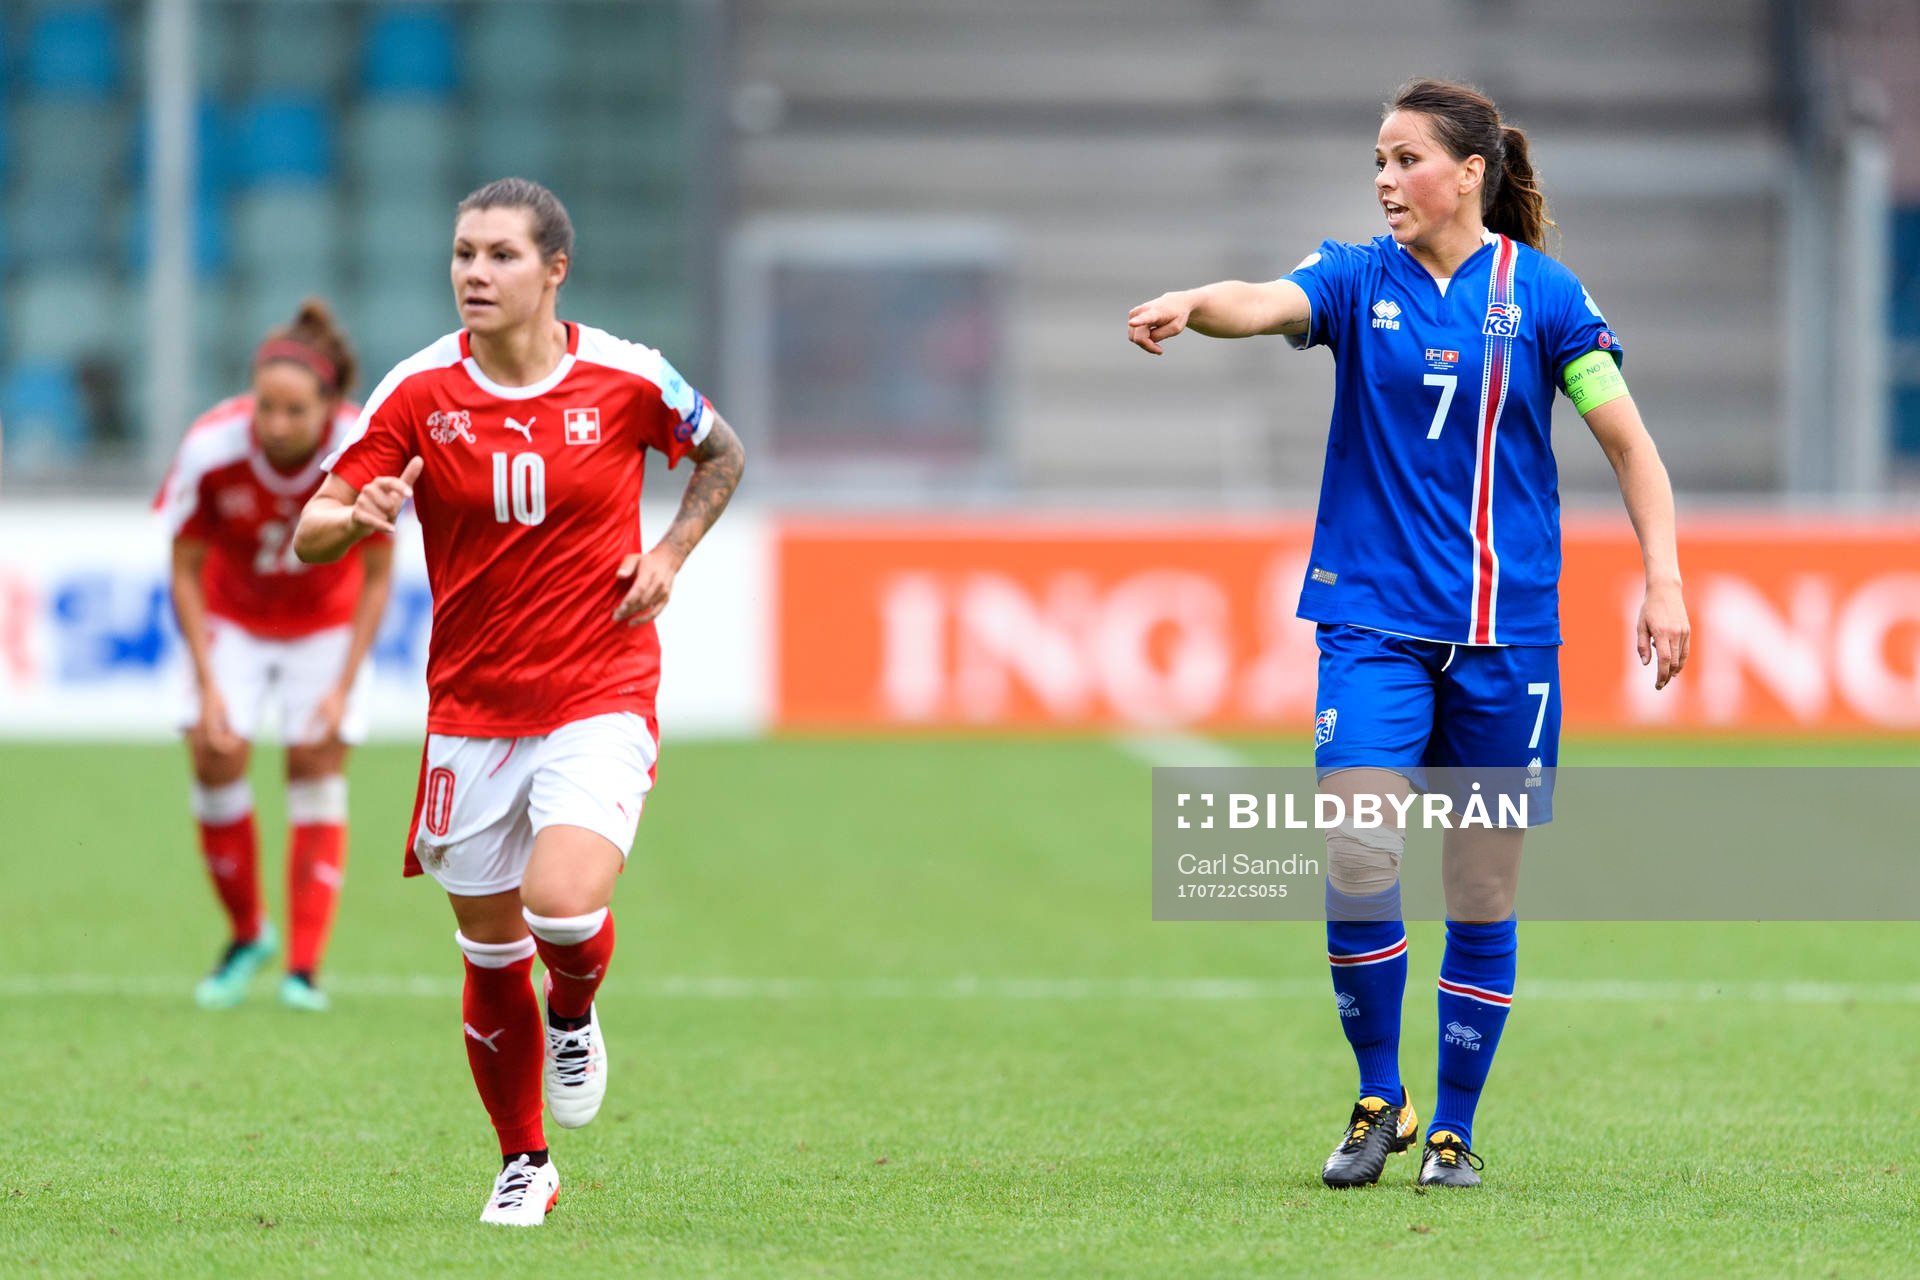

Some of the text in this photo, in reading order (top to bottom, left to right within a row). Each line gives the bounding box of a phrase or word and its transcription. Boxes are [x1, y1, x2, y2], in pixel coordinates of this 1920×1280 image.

[1586, 364, 1601, 375] NO
[1424, 374, 1458, 440] 7
[492, 452, 546, 527] 10
[886, 572, 1230, 722] ING
[1528, 682, 1550, 749] 7
